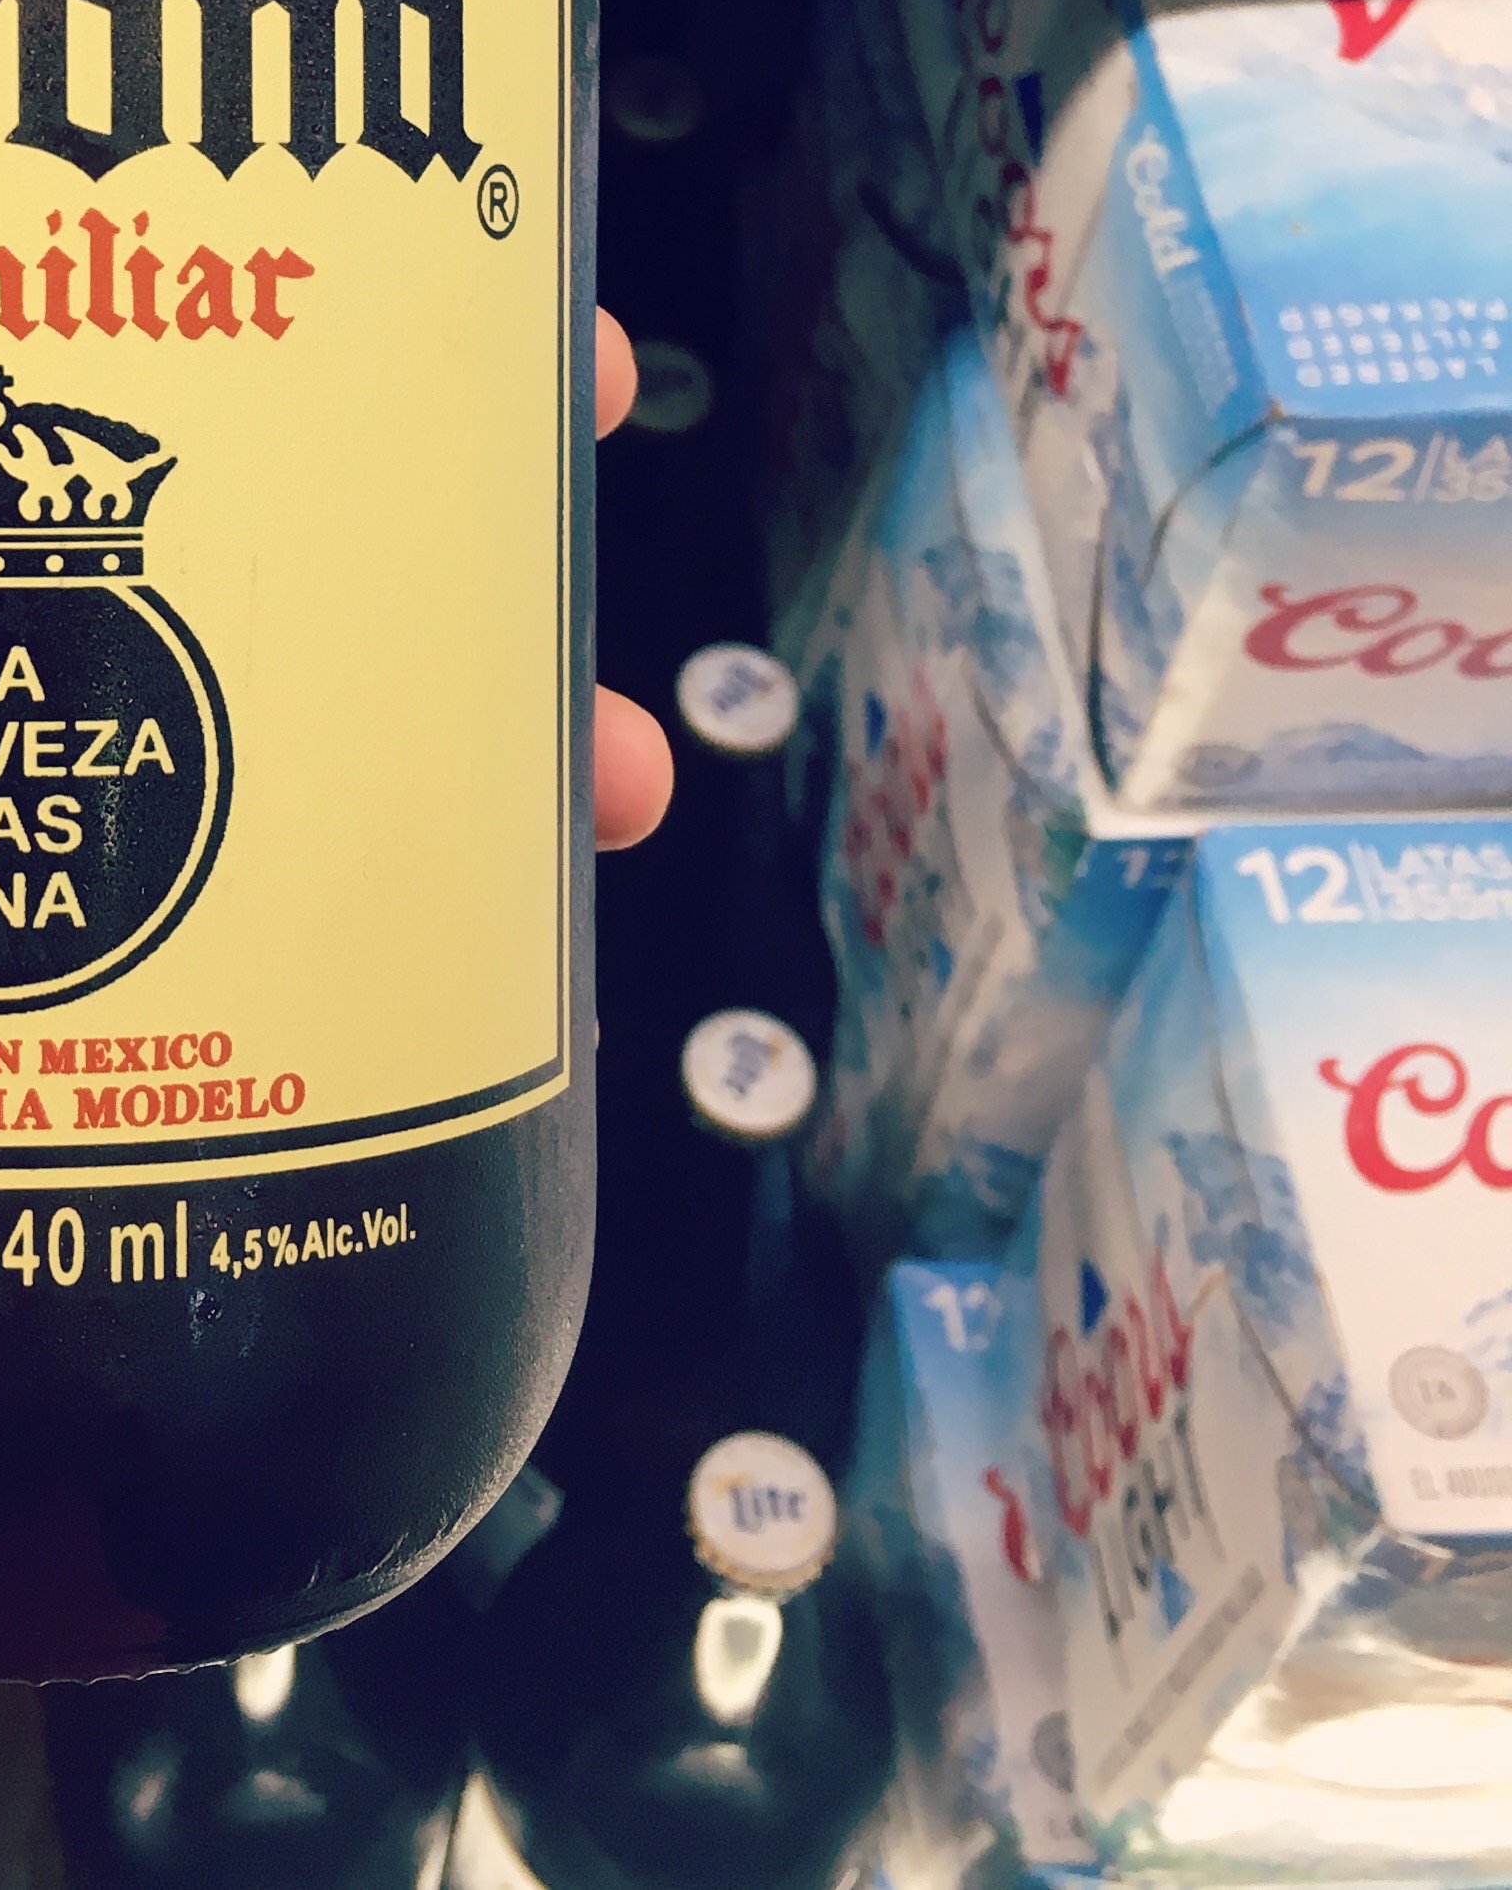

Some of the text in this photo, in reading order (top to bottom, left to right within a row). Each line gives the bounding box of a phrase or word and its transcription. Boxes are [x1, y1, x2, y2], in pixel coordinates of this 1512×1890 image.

[1291, 439, 1417, 504] 12
[1236, 843, 1365, 925] 12
[39, 1030, 234, 1075] MEXICO
[73, 1072, 307, 1130] MODELO
[109, 1200, 188, 1283] ml
